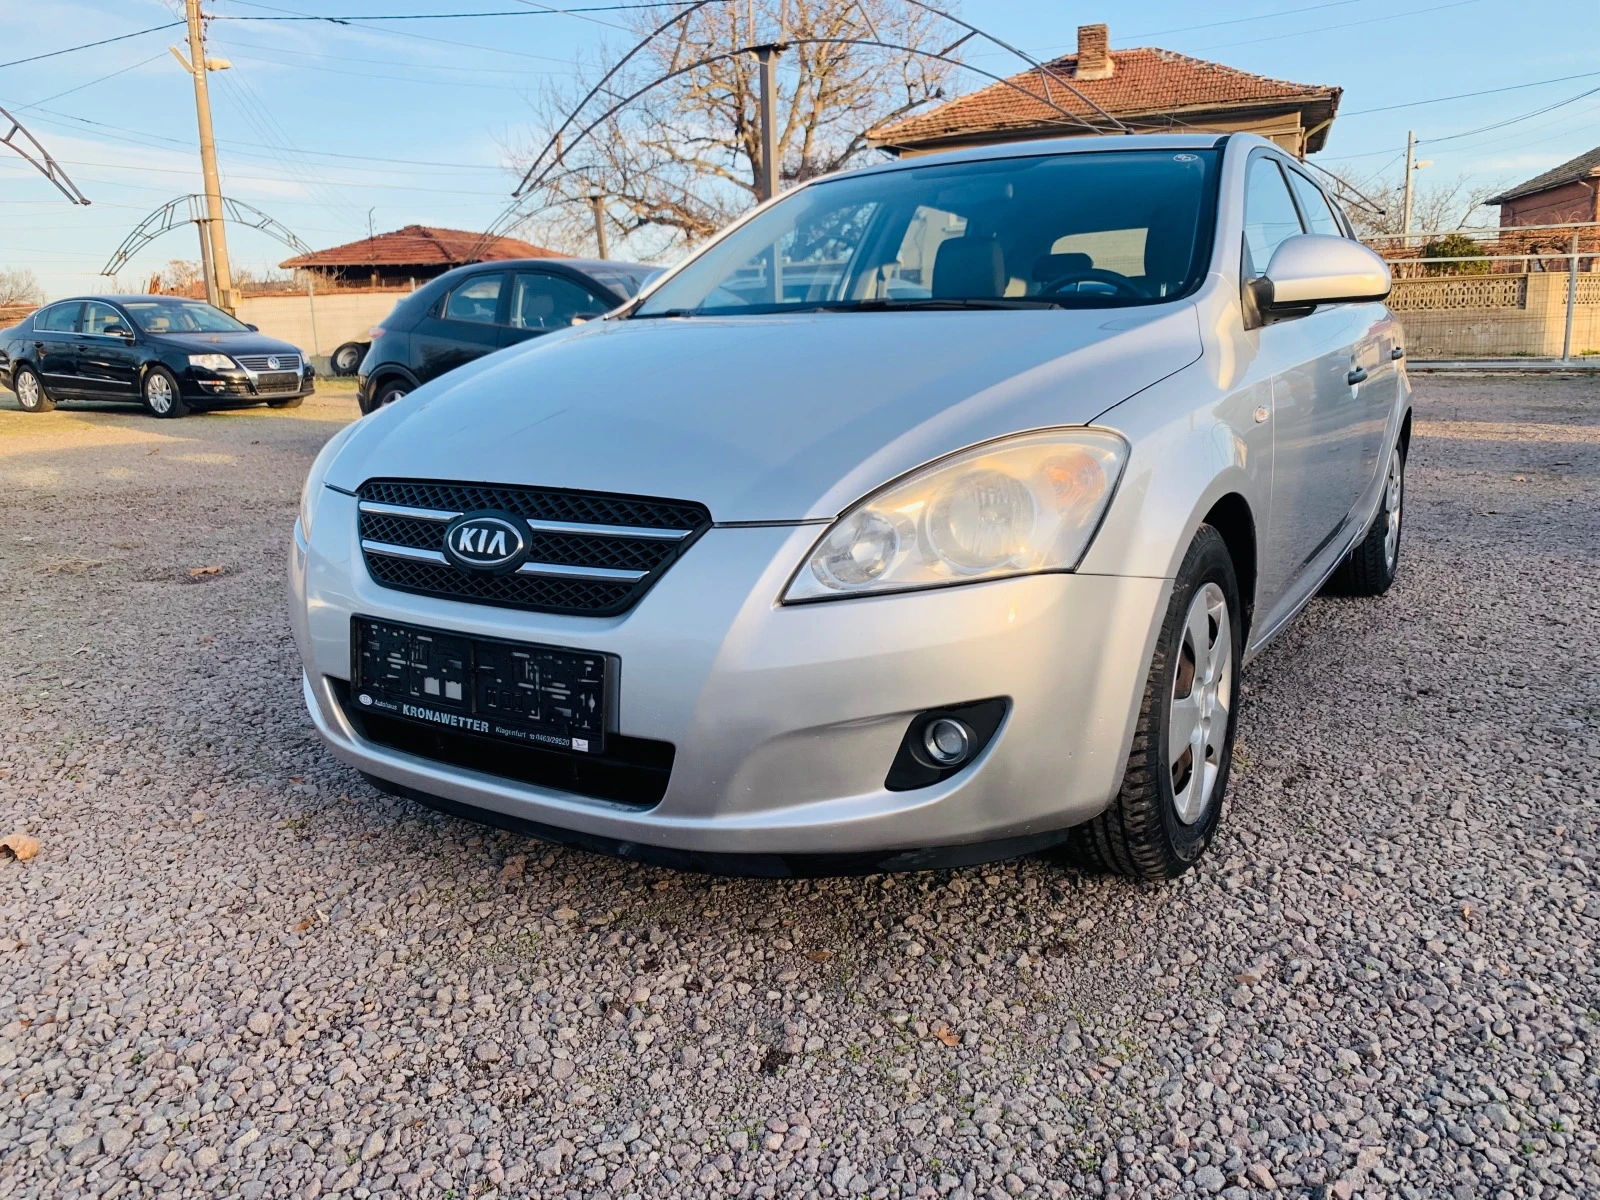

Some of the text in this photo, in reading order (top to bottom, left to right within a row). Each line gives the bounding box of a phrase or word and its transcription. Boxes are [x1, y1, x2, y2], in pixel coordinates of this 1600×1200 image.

[458, 527, 507, 556] KIA
[374, 699, 397, 710] Autohaus
[402, 704, 489, 733] KRONAWETTER
[495, 726, 526, 739] Klagenfurt
